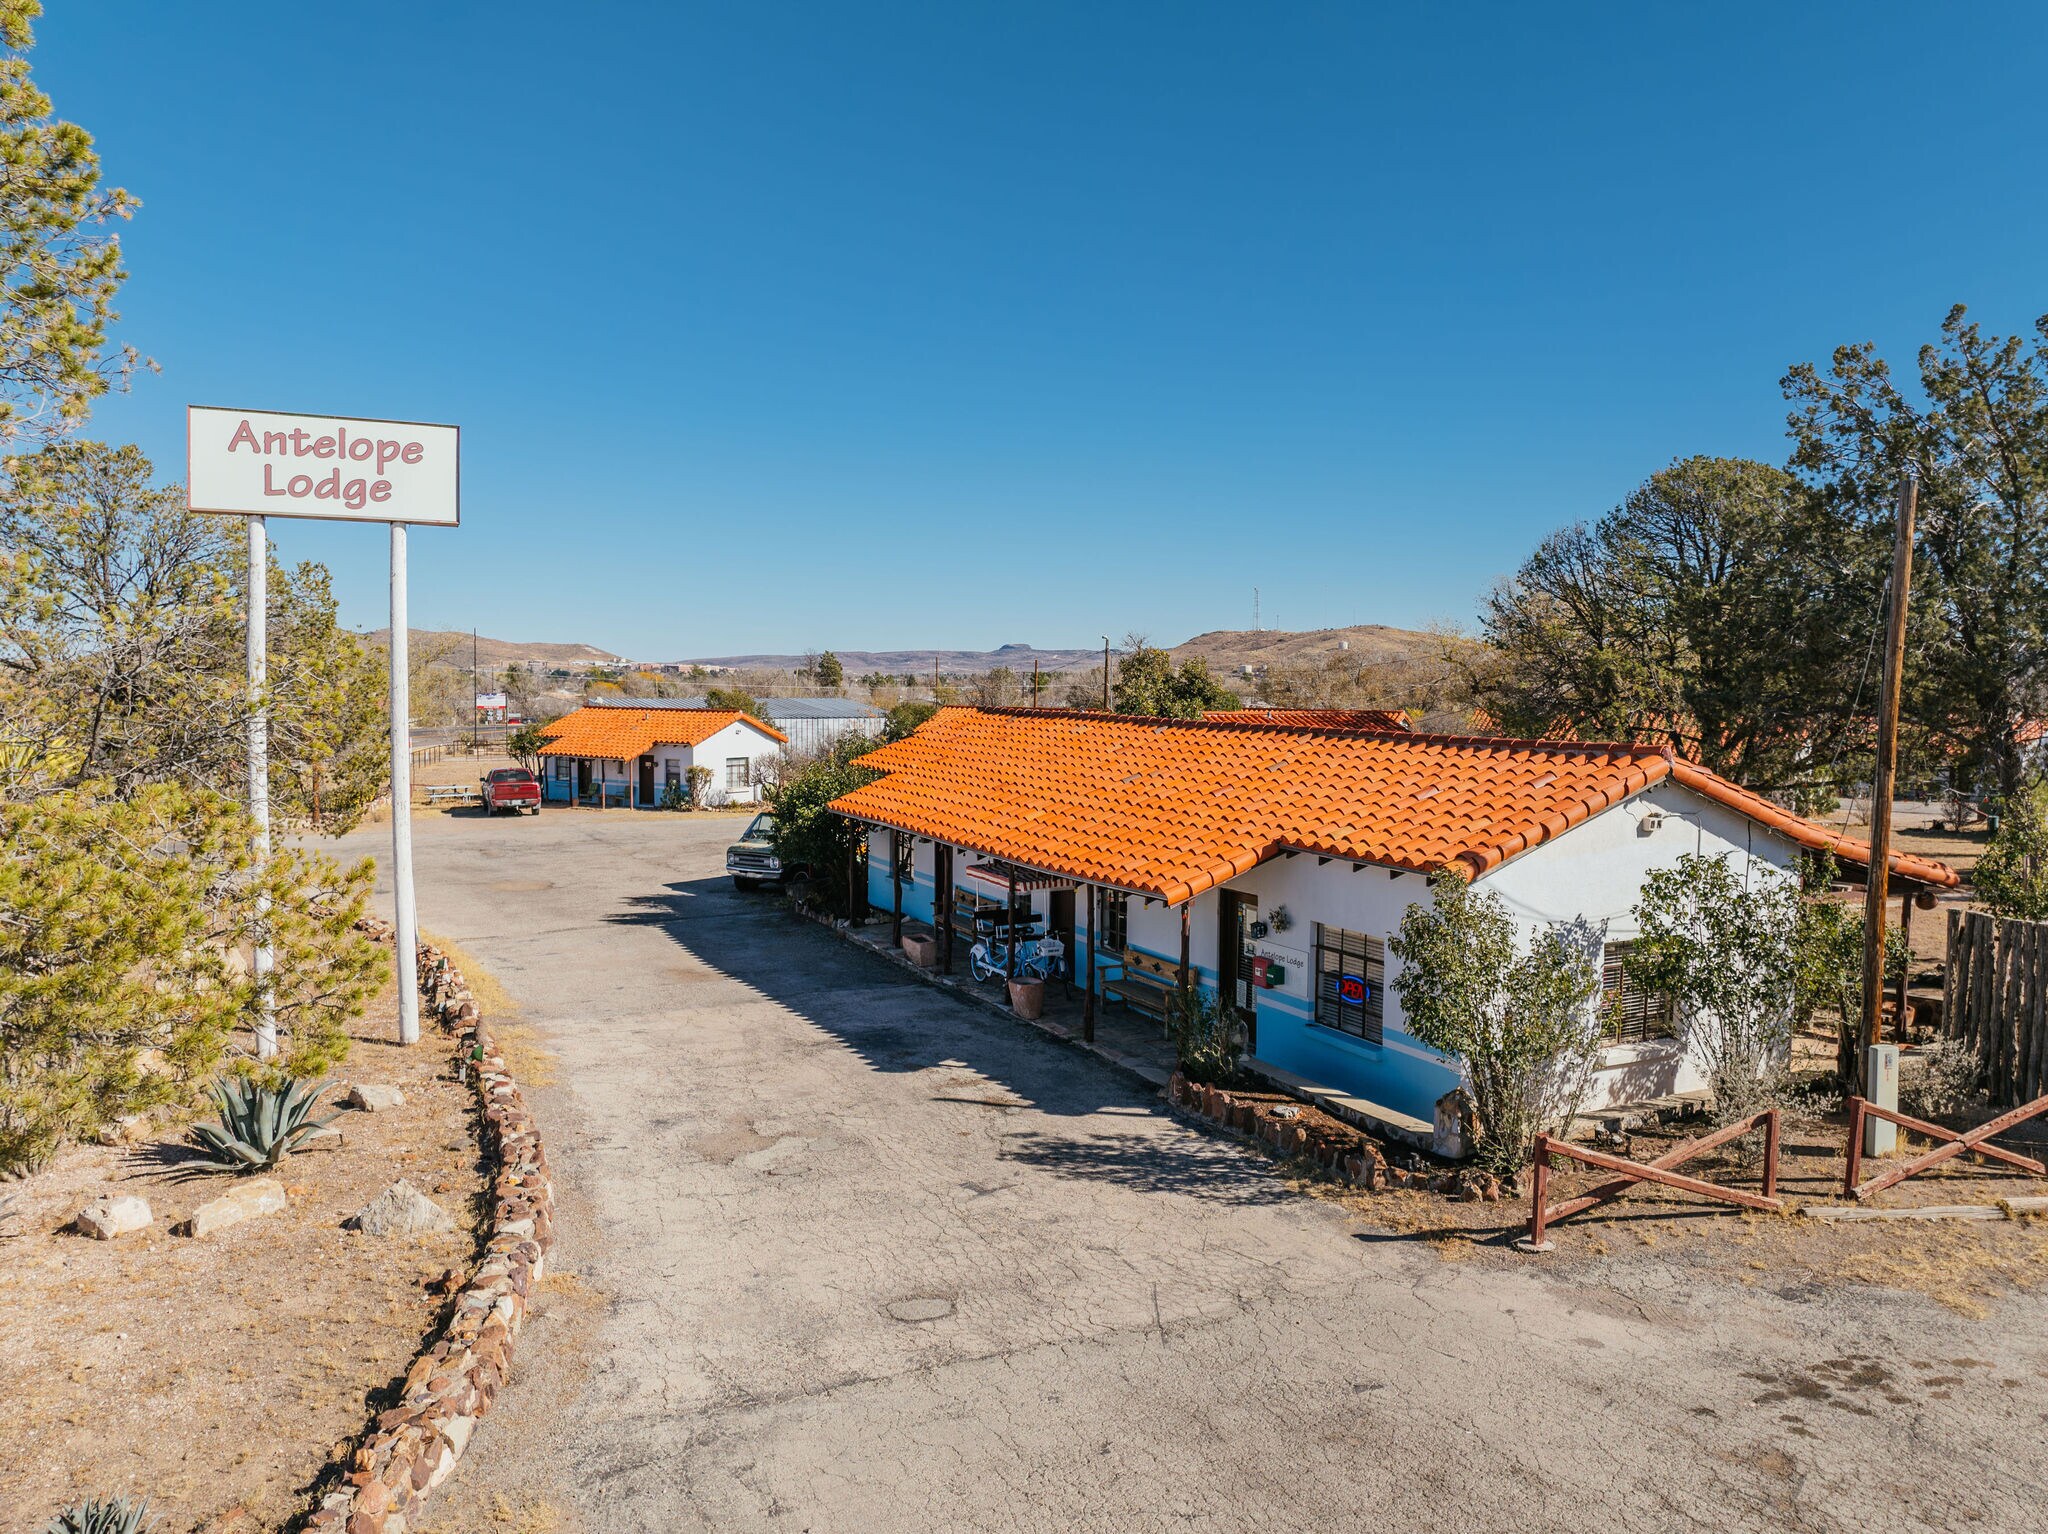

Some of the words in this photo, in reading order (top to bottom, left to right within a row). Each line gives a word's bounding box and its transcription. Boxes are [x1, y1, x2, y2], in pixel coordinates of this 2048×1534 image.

[227, 419, 424, 475] Antelope
[263, 463, 392, 510] Lodge
[1260, 948, 1286, 964] Antelope
[1286, 954, 1305, 969] Lodge
